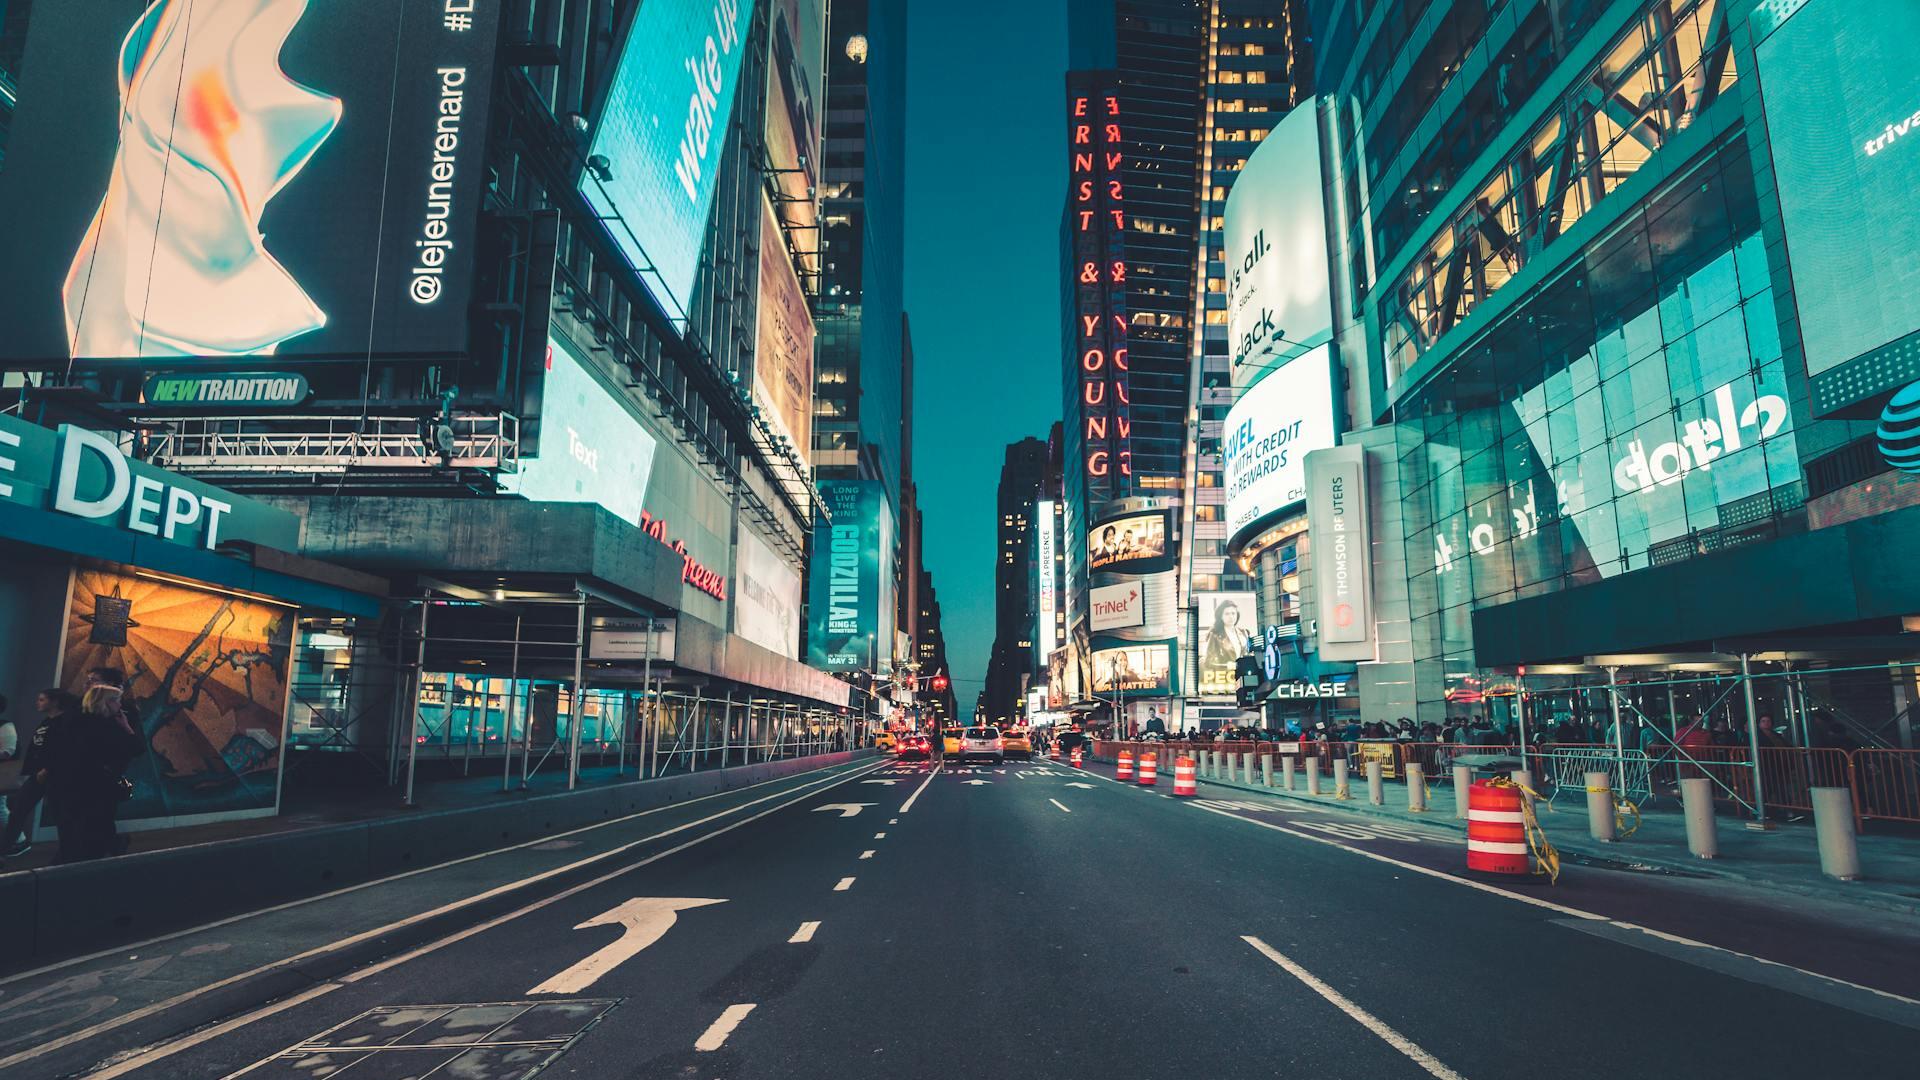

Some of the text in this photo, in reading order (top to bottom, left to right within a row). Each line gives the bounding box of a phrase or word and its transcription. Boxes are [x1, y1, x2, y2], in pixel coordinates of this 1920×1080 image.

[675, 35, 722, 204] wake
[410, 67, 466, 303] @lejeunerenard
[1244, 228, 1271, 275] all.
[1075, 98, 1108, 476] ERNST & YOUNG
[153, 379, 299, 401] NEWTRADITION
[567, 425, 598, 473] Text
[1255, 419, 1303, 459] CREDIT
[833, 486, 860, 494] LONG
[1238, 449, 1288, 493] REWARDS
[835, 494, 856, 502] LIVE
[1042, 530, 1050, 570] PRESENCE
[1335, 534, 1348, 598] THOMSON
[829, 524, 860, 621] GODZILLA
[829, 620, 849, 628] KING
[1093, 599, 1128, 616] TriNet
[1277, 682, 1347, 698] CHASE
